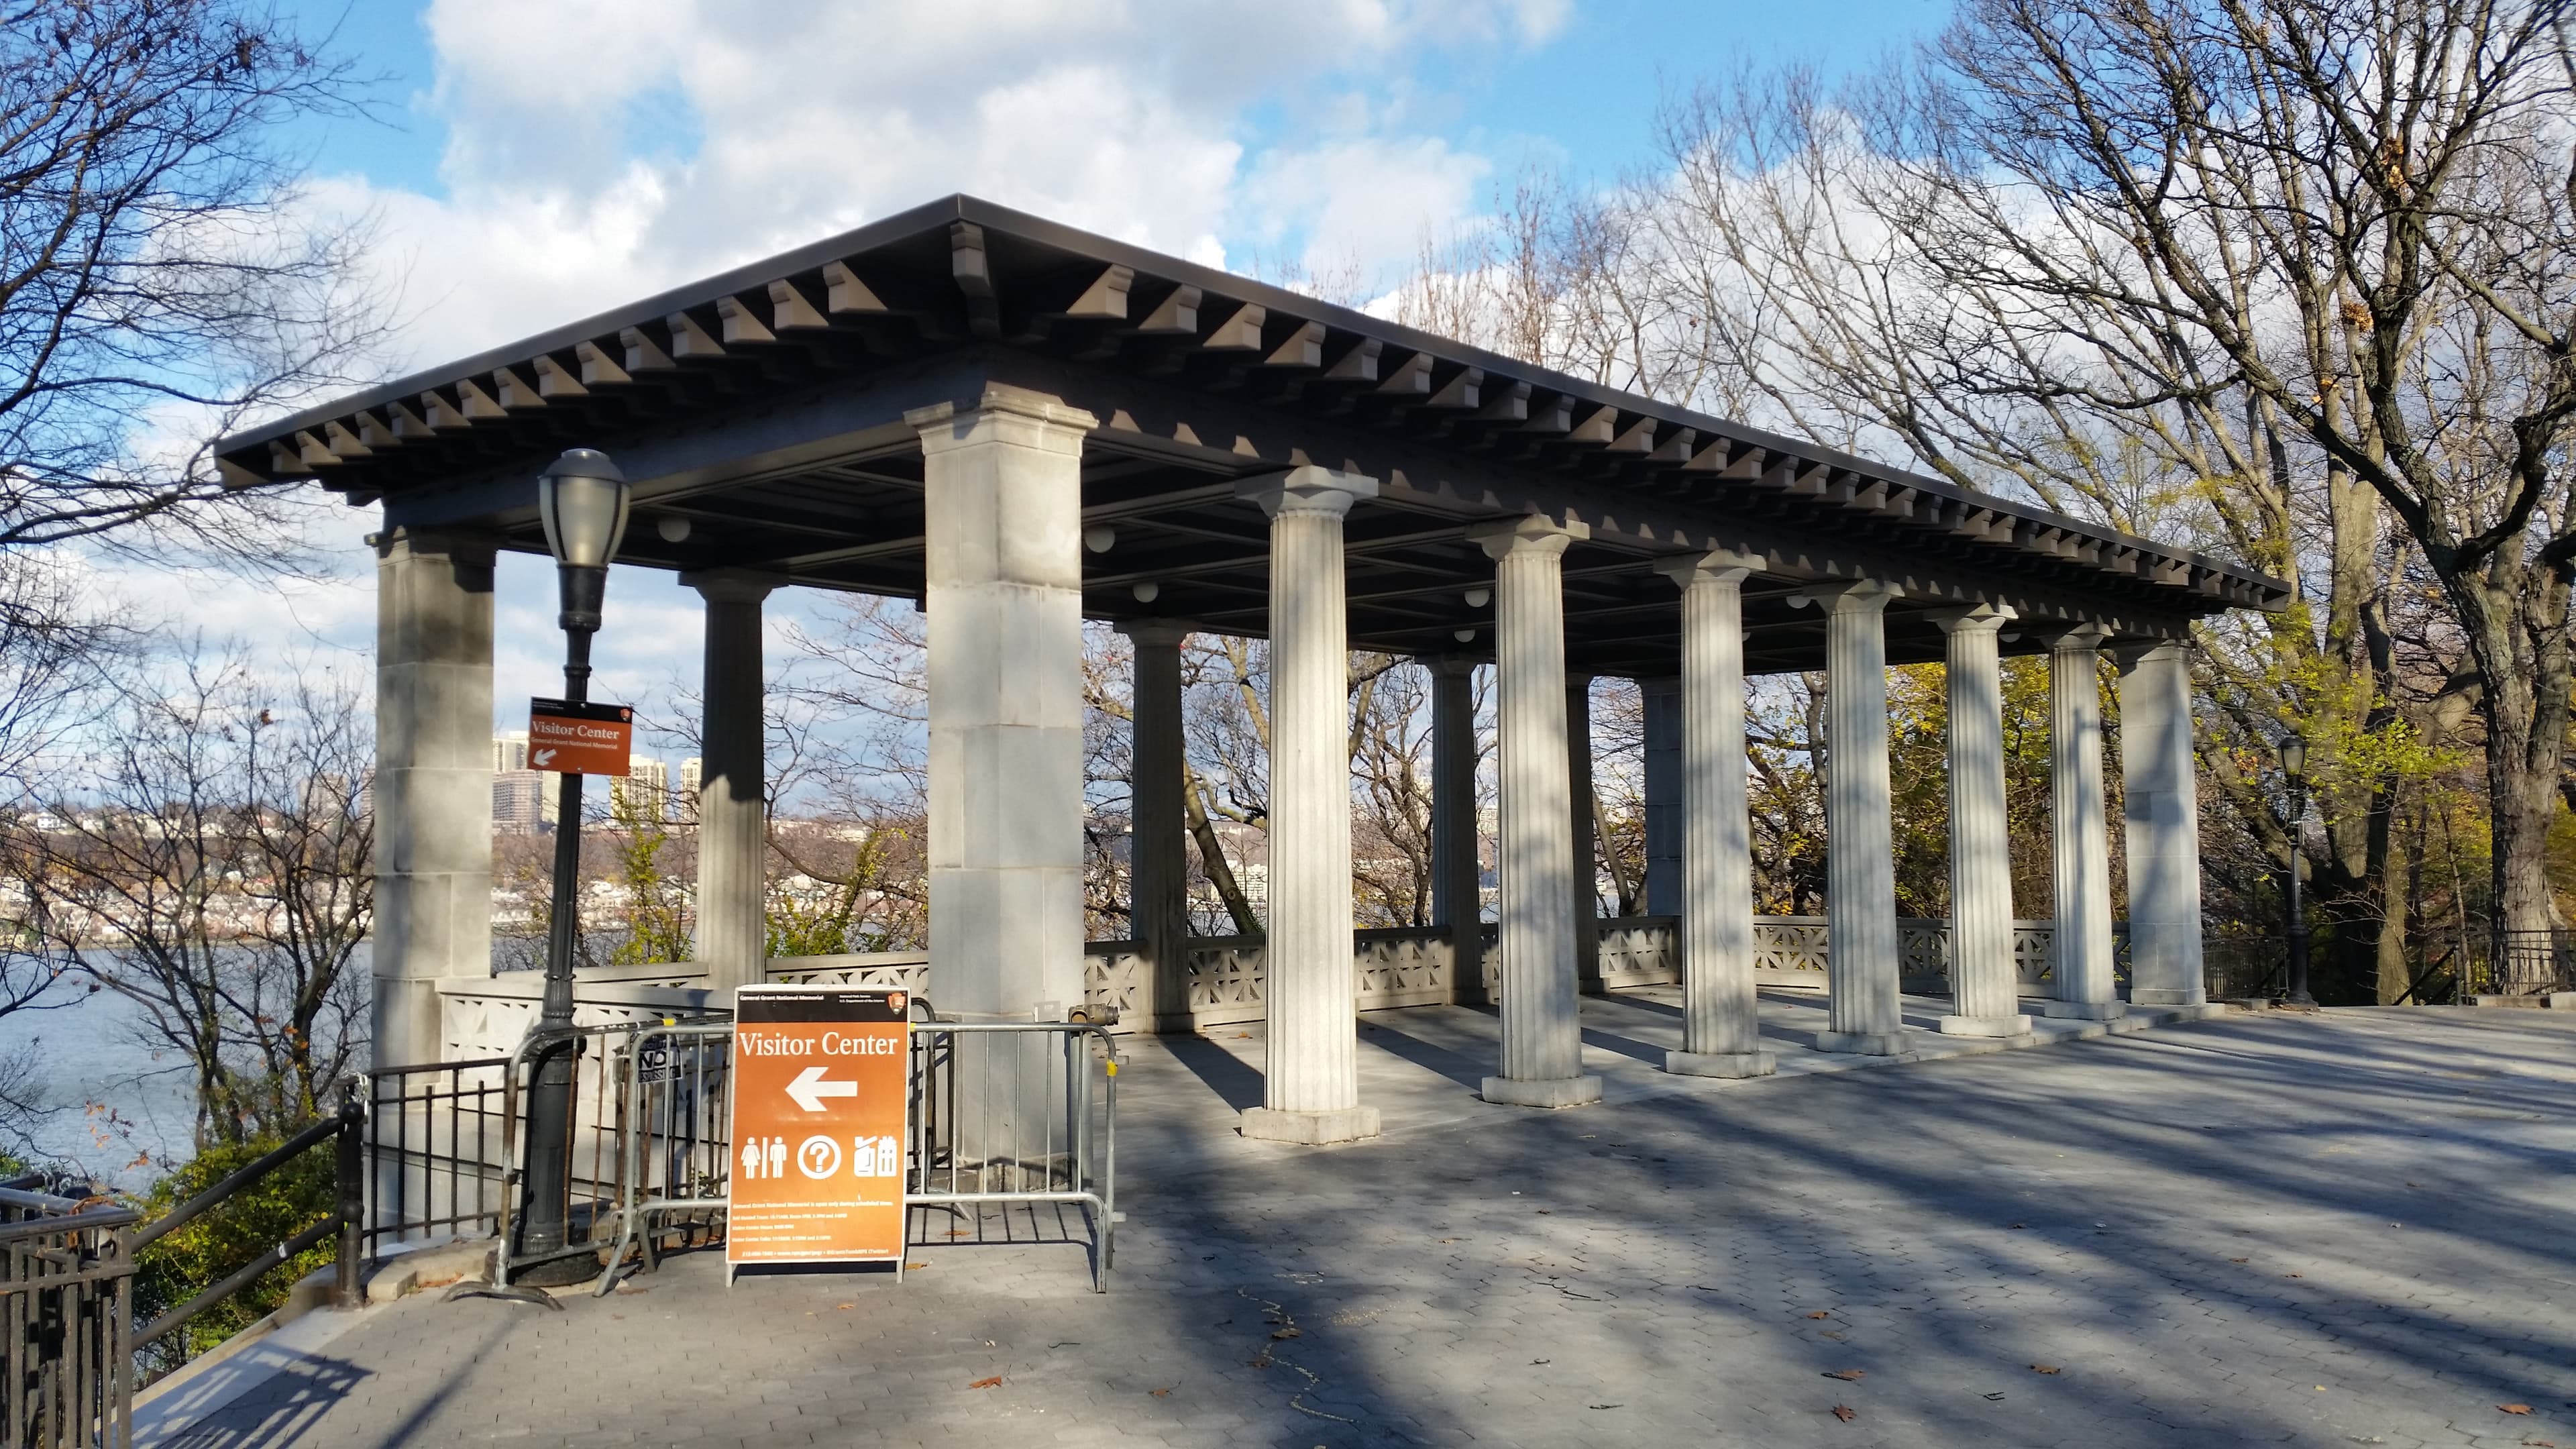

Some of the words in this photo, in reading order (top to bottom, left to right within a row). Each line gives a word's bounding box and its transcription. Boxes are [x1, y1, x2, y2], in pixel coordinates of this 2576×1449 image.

[533, 721, 575, 735] Visitor
[577, 725, 619, 739] Center
[739, 1032, 815, 1056] Visitor
[822, 1032, 898, 1055] Center
